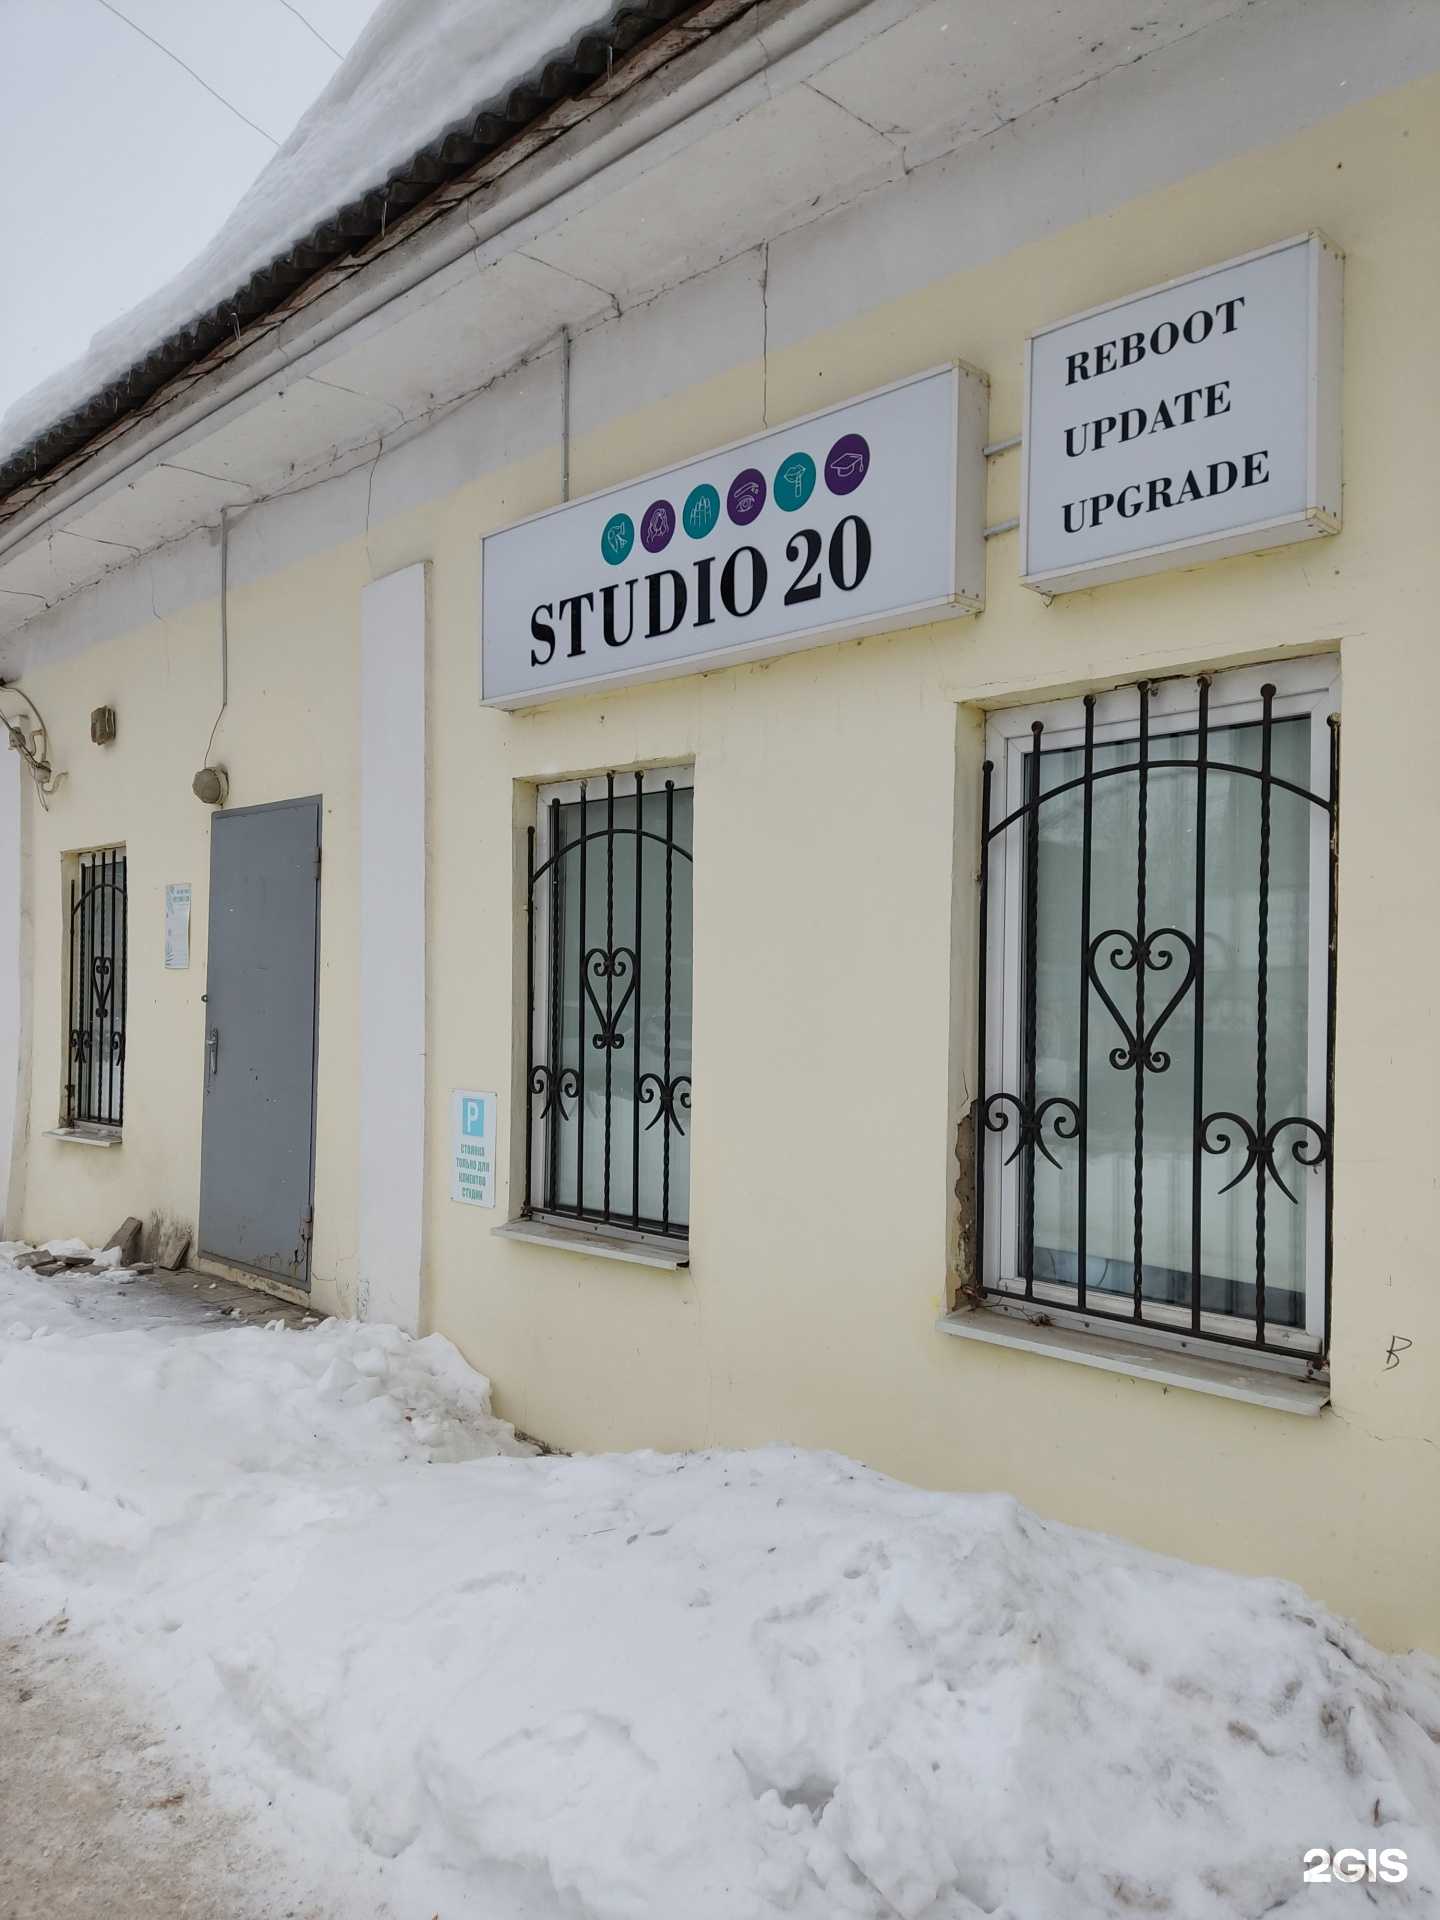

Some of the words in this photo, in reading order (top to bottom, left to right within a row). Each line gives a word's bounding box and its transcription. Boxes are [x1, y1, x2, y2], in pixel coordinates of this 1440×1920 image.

[1065, 296, 1245, 386] REBOOT
[1064, 380, 1231, 458] UPDATE
[1061, 450, 1270, 534] UPGRADE
[530, 545, 768, 668] STUDIO
[784, 515, 872, 606] 20
[456, 1157, 477, 1170] ТОЛЬКО
[477, 1160, 490, 1173] ДЛЯ
